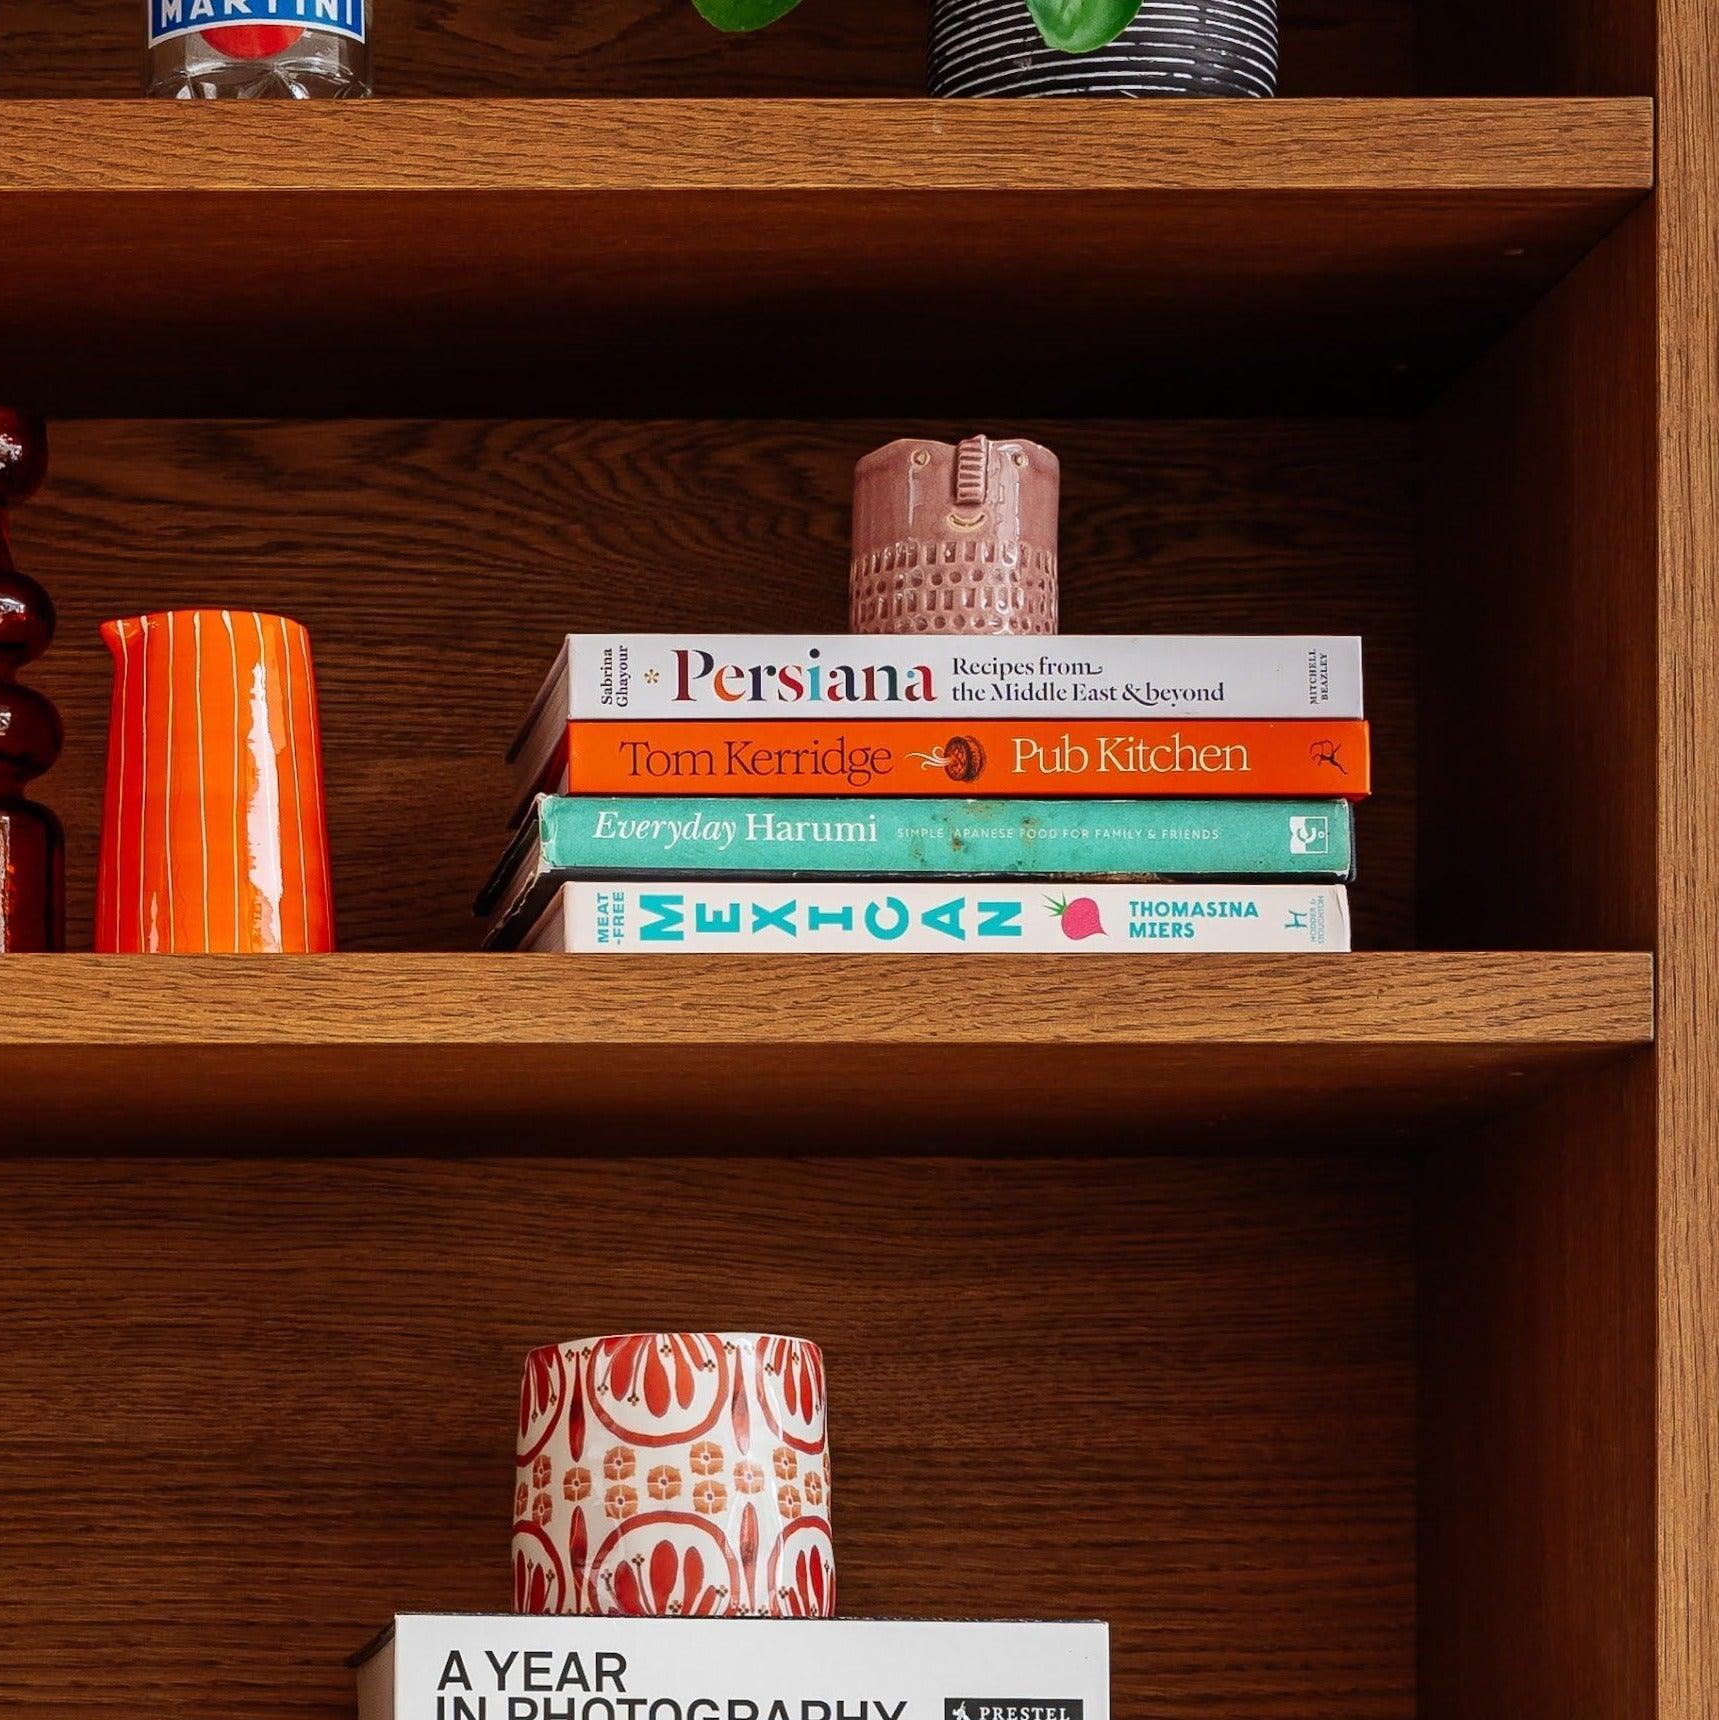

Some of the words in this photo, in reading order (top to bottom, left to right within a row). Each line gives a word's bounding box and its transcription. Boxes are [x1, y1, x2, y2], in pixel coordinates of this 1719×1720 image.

[601, 648, 613, 706] Sabrina
[616, 644, 629, 708] Ghayour
[670, 648, 938, 702] Persiana
[951, 656, 1036, 680] Recipes
[1039, 655, 1103, 676] from
[1309, 648, 1317, 705] MITCHELL
[1321, 653, 1329, 701] BEAZLEY
[951, 682, 986, 702] the
[989, 681, 1068, 702] Middle
[1072, 682, 1118, 702] East
[619, 740, 714, 777] Tom
[723, 736, 894, 788] Kerridge
[1011, 733, 1089, 774] Pub
[1096, 731, 1252, 773] Kitchen
[592, 810, 737, 851] Everyday
[745, 811, 878, 843] Harumi
[896, 827, 944, 840] SIMPLE
[948, 827, 1014, 842] JAPANESE
[1019, 827, 1058, 840] FOOD
[1062, 827, 1089, 840] FOR
[1095, 827, 1143, 840] FAMILY
[1147, 828, 1156, 840] &
[1161, 827, 1220, 840] FRIENDS
[596, 892, 610, 944] MEAT
[639, 894, 1022, 942] MEXICAN
[1129, 900, 1259, 918] THOMASINA
[1129, 922, 1195, 939] MIERS
[436, 1649, 473, 1692] A
[485, 1650, 628, 1693] YEAR
